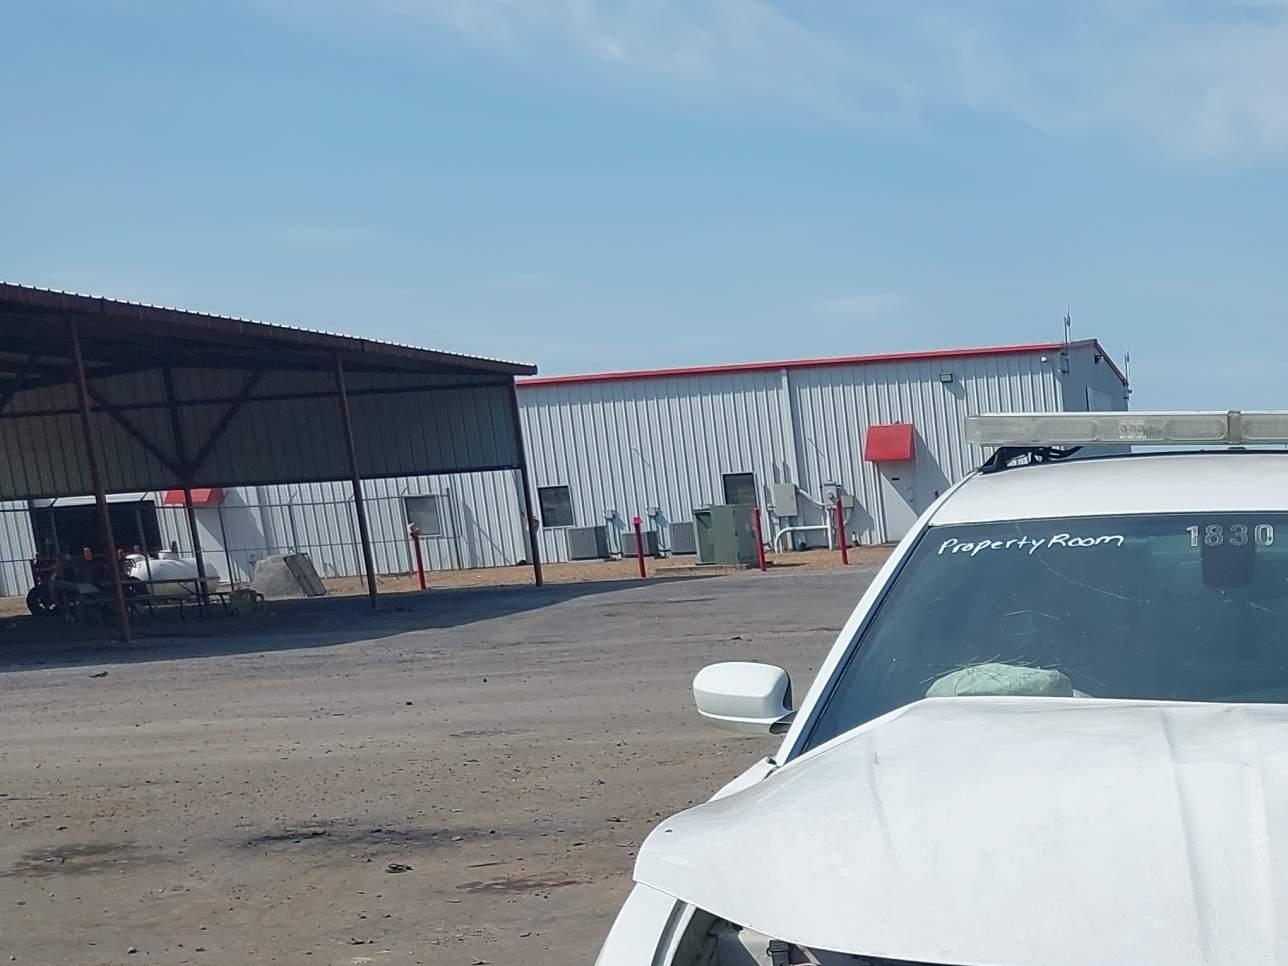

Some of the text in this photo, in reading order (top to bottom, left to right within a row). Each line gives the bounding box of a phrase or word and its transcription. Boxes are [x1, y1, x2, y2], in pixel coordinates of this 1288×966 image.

[937, 533, 1125, 557] Property Room
[1186, 524, 1274, 546] 1830
